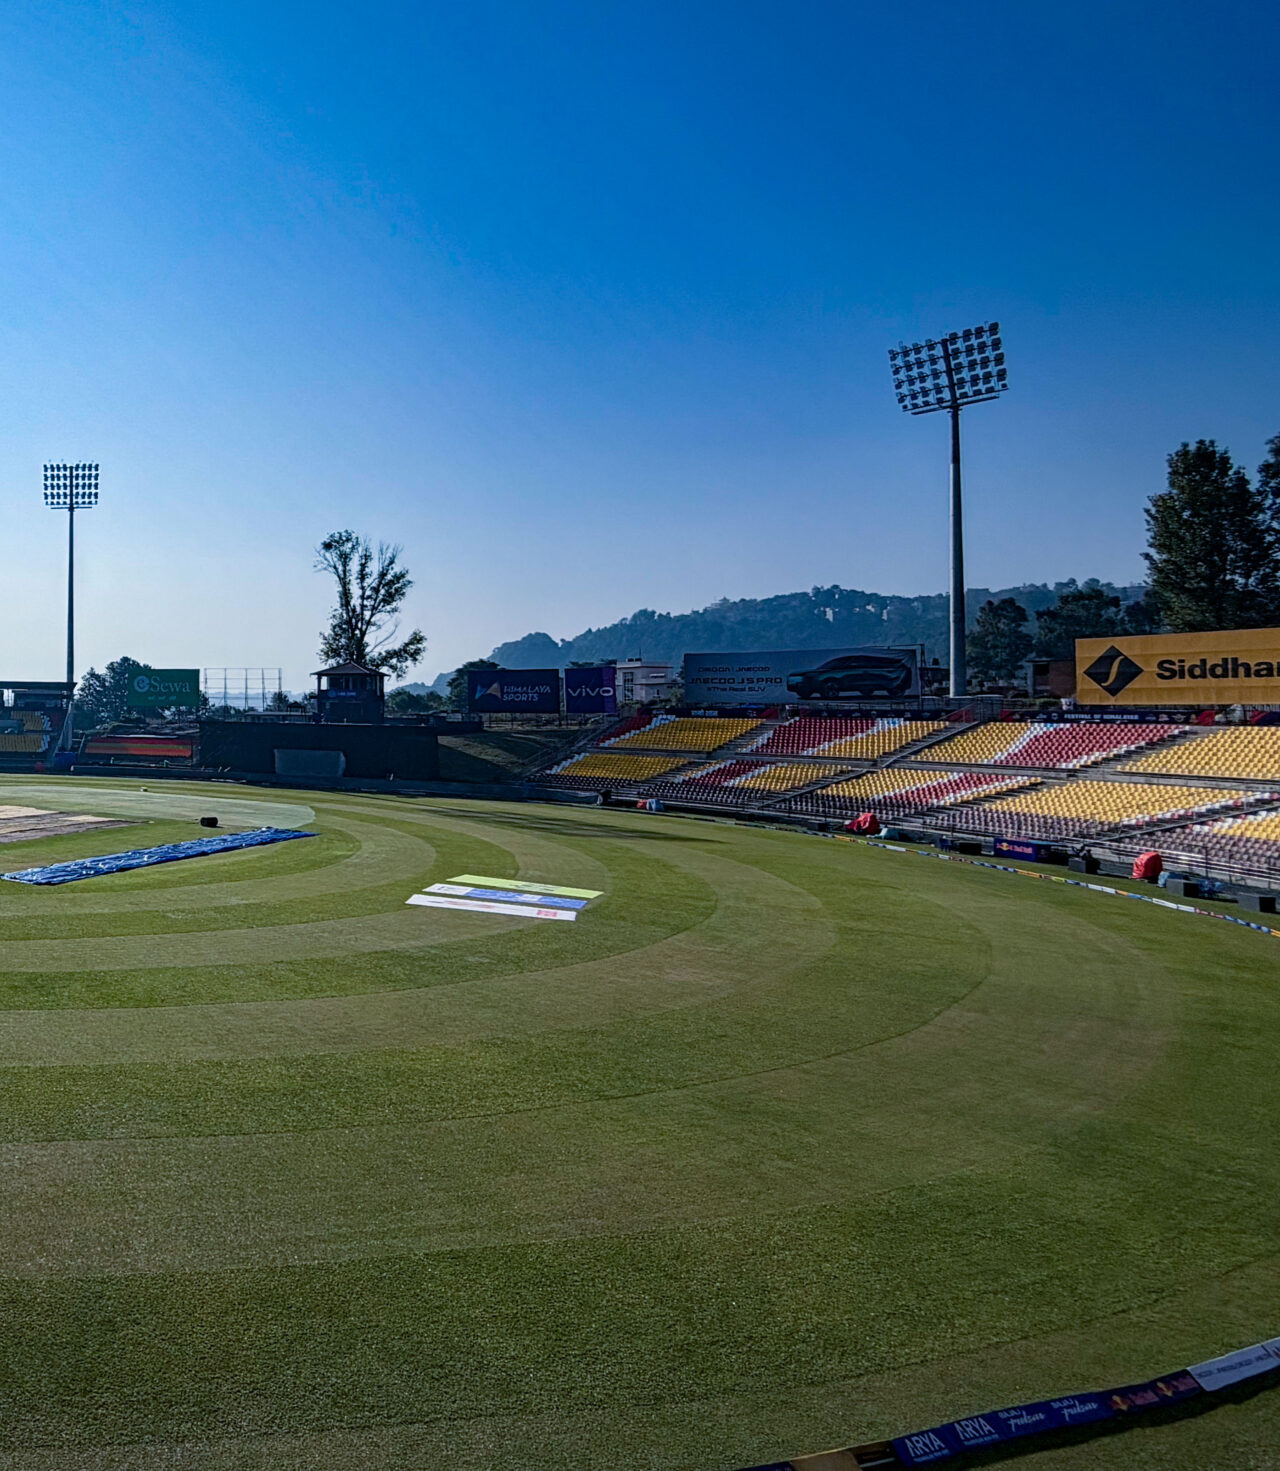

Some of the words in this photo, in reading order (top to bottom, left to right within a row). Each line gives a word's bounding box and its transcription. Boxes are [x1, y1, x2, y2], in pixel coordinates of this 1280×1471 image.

[1156, 657, 1280, 680] Siddha
[503, 693, 539, 702] SPORTS
[504, 685, 551, 693] HIMALAYA
[567, 685, 614, 697] vivo
[952, 1418, 995, 1441] ARYA
[904, 1431, 946, 1458] ARYA
